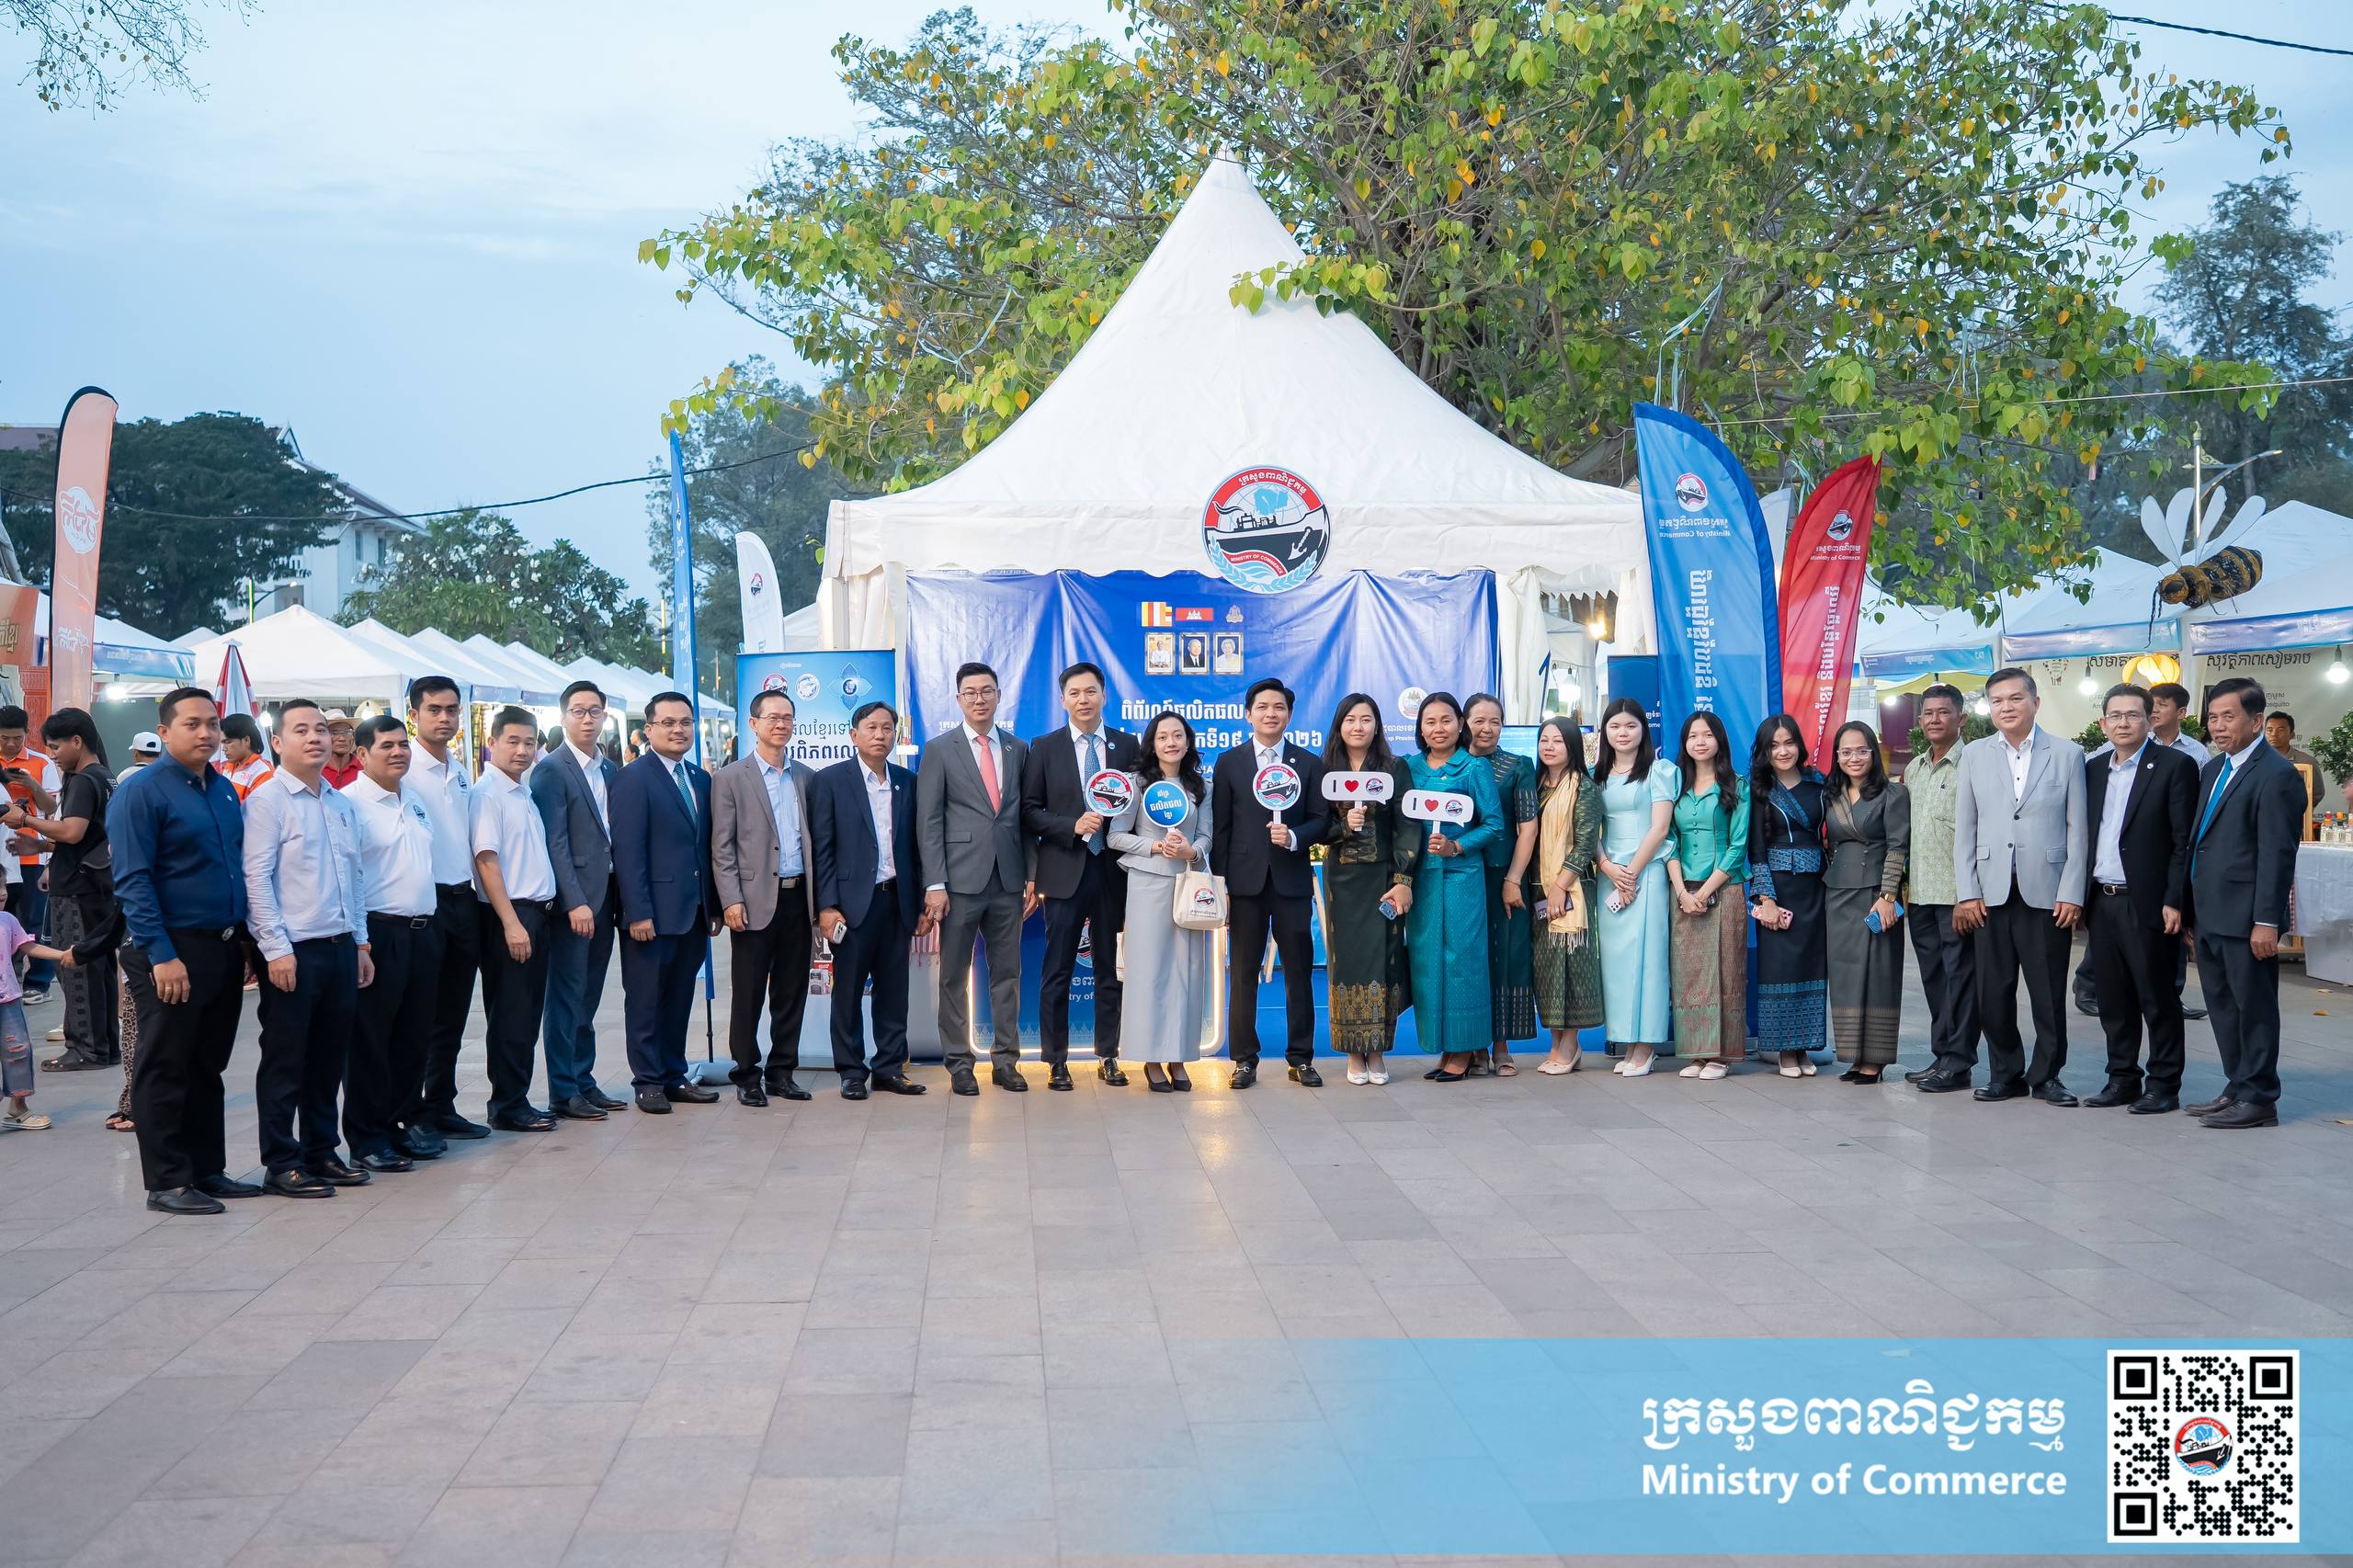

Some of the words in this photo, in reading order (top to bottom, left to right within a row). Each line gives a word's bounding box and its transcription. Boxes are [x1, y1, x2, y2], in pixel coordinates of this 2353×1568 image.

[1231, 554, 1252, 562] MINISTRY
[1260, 555, 1284, 575] COMMERCE
[1333, 779, 1336, 793] I
[1413, 797, 1416, 811] I
